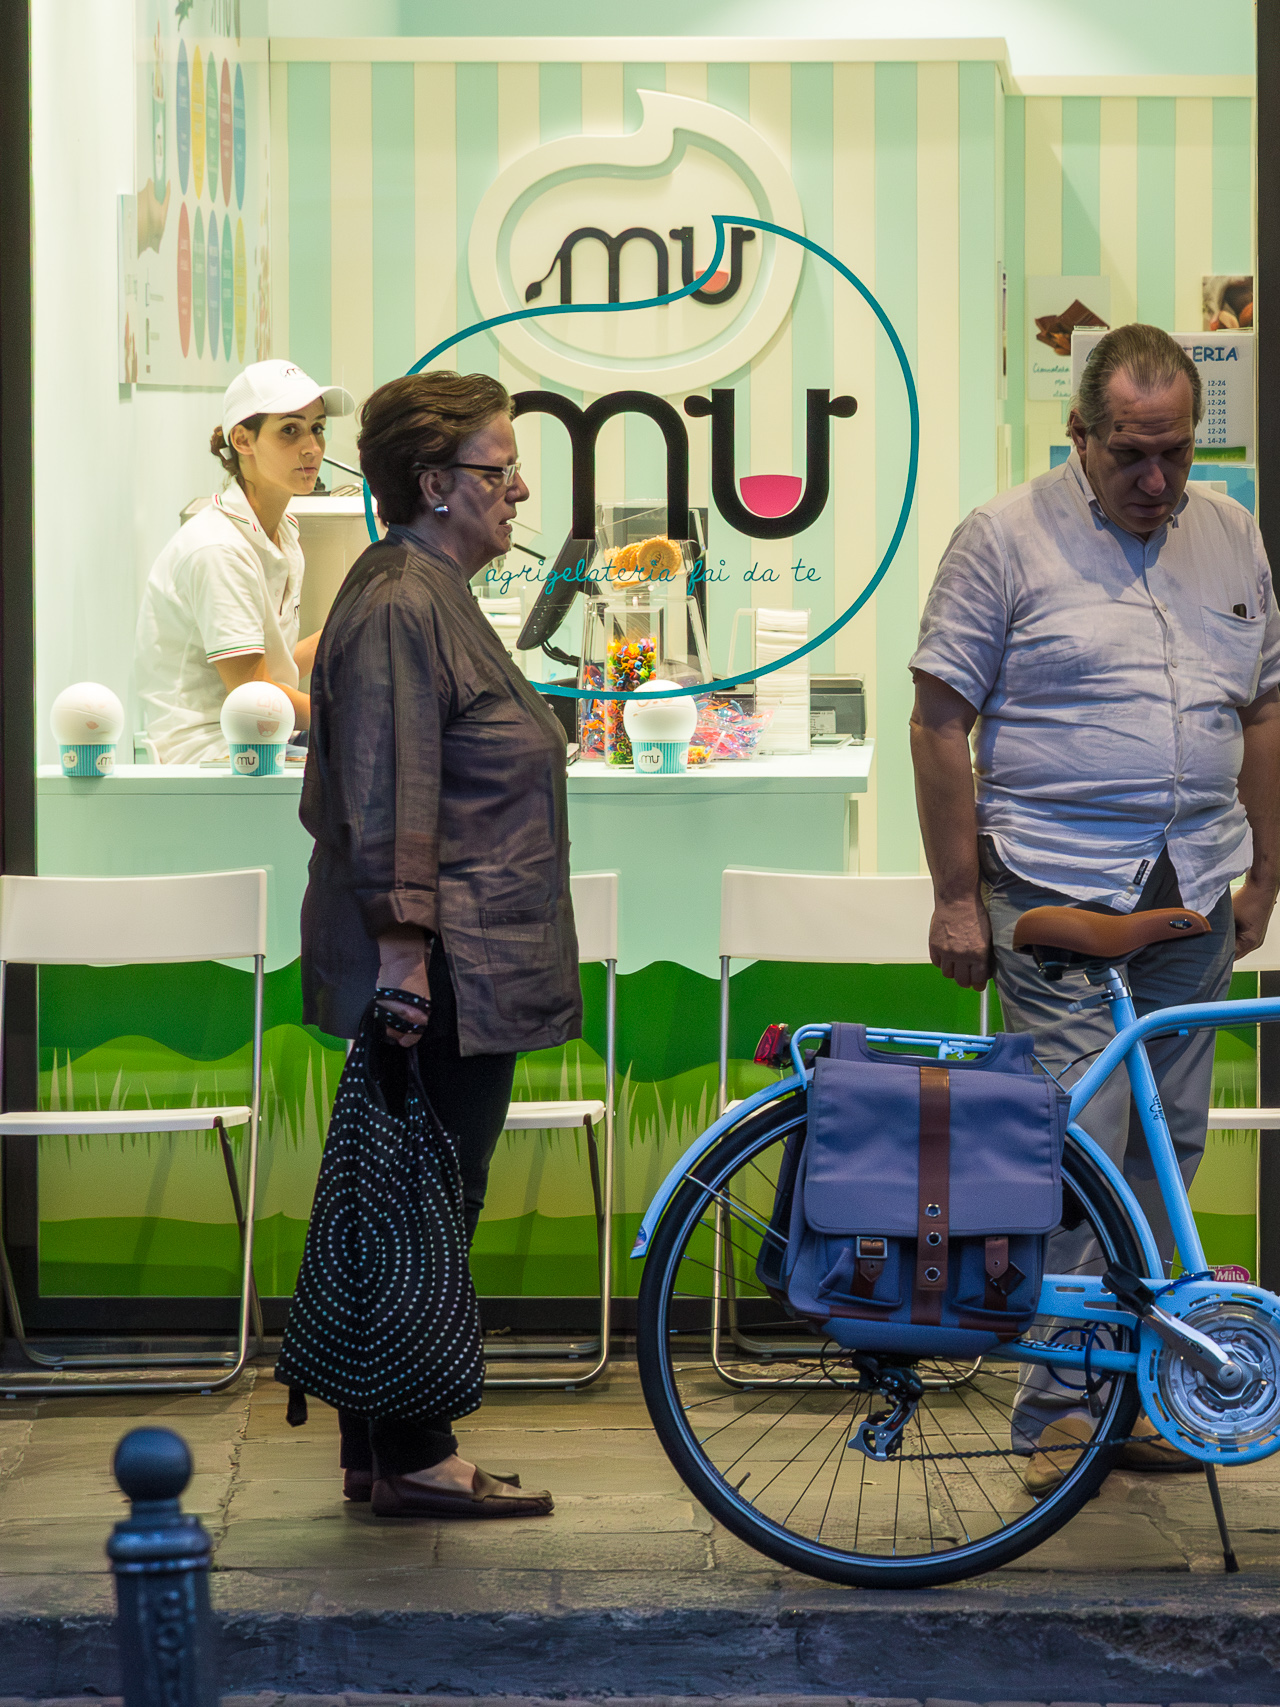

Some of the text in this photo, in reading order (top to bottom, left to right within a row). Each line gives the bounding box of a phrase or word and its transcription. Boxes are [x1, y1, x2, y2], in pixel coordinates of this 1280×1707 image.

[485, 558, 676, 595] agrigelateria
[687, 559, 731, 596] fai
[743, 561, 781, 582] da
[791, 558, 822, 582] te
[1216, 1270, 1246, 1281] Milù
